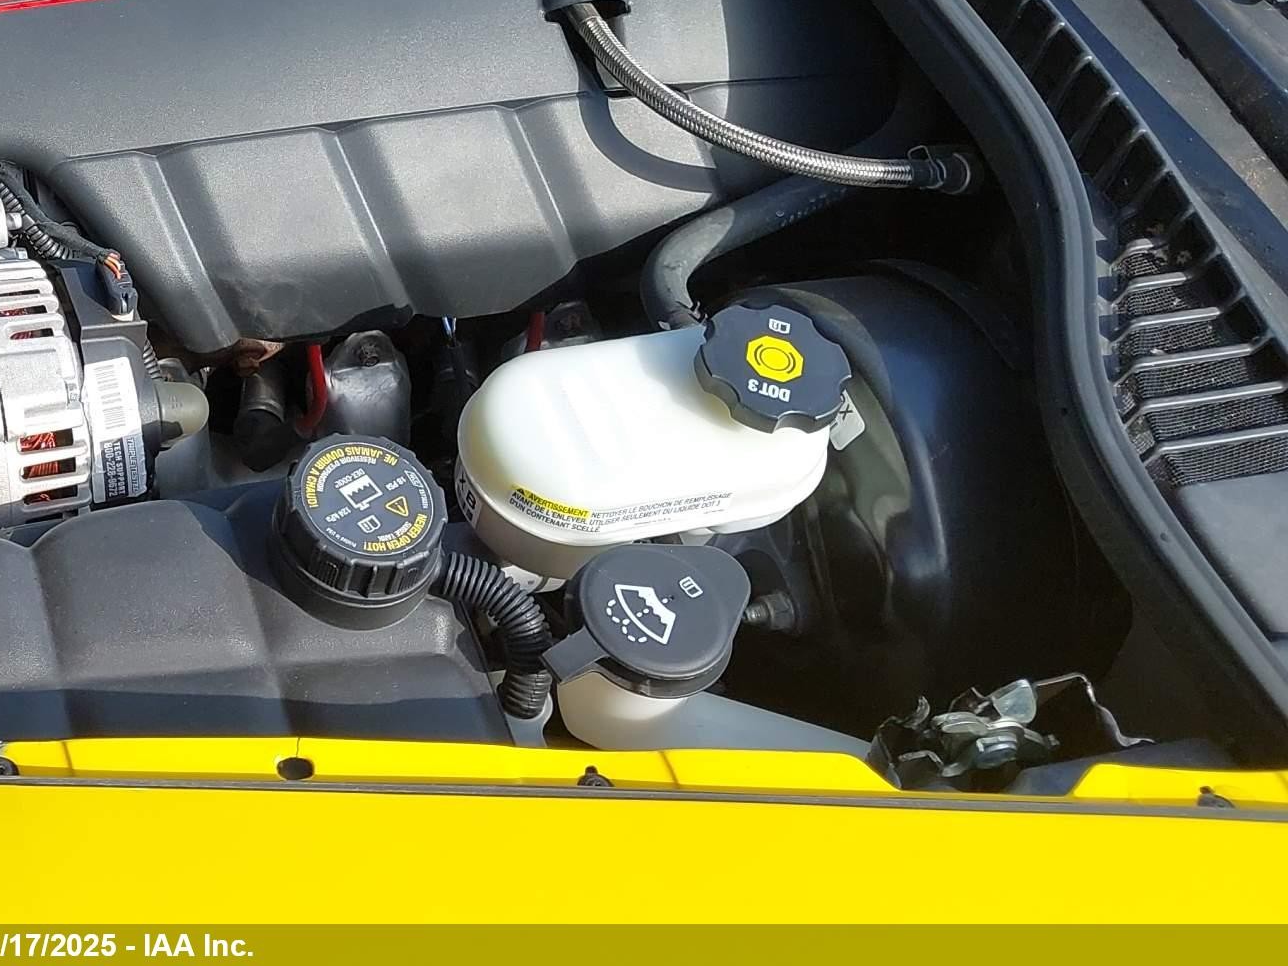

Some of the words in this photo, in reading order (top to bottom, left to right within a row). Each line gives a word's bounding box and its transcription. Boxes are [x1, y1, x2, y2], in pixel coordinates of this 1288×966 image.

[747, 378, 760, 392] 3
[758, 382, 791, 403] DOT
[113, 441, 122, 461] TECH
[127, 438, 137, 467] TRIPLE
[314, 448, 344, 468] OUVRIR
[345, 446, 383, 459] JAMAIS
[383, 453, 399, 466] NE
[104, 442, 118, 497] 800-228-9672
[116, 461, 126, 495] SUPPORT
[385, 481, 399, 491] PSI
[397, 475, 407, 485] 18
[305, 474, 319, 509] CHAUD!
[340, 506, 352, 517] 124
[509, 498, 527, 514] D'UN
[526, 508, 572, 530] CONTENANT
[511, 491, 535, 507] AVANT
[534, 502, 546, 514] DE
[589, 516, 621, 526] UTILISER
[621, 509, 662, 522] SEULEMENT
[662, 507, 674, 515] DU
[674, 502, 704, 513] LIQUIDE
[703, 500, 715, 509] DOT
[528, 492, 590, 517] AVERTISSEMENT
[591, 509, 627, 519] NETTOYER
[627, 507, 638, 515] LE
[638, 500, 674, 512] BOUCHON
[674, 498, 684, 506] DE
[684, 492, 733, 505] REMPLISSAGE
[325, 511, 341, 523] kPa
[410, 513, 428, 537] NEVER
[363, 540, 387, 552] HOT!
[377, 532, 393, 542] TANK
[388, 534, 411, 550] OPEN
